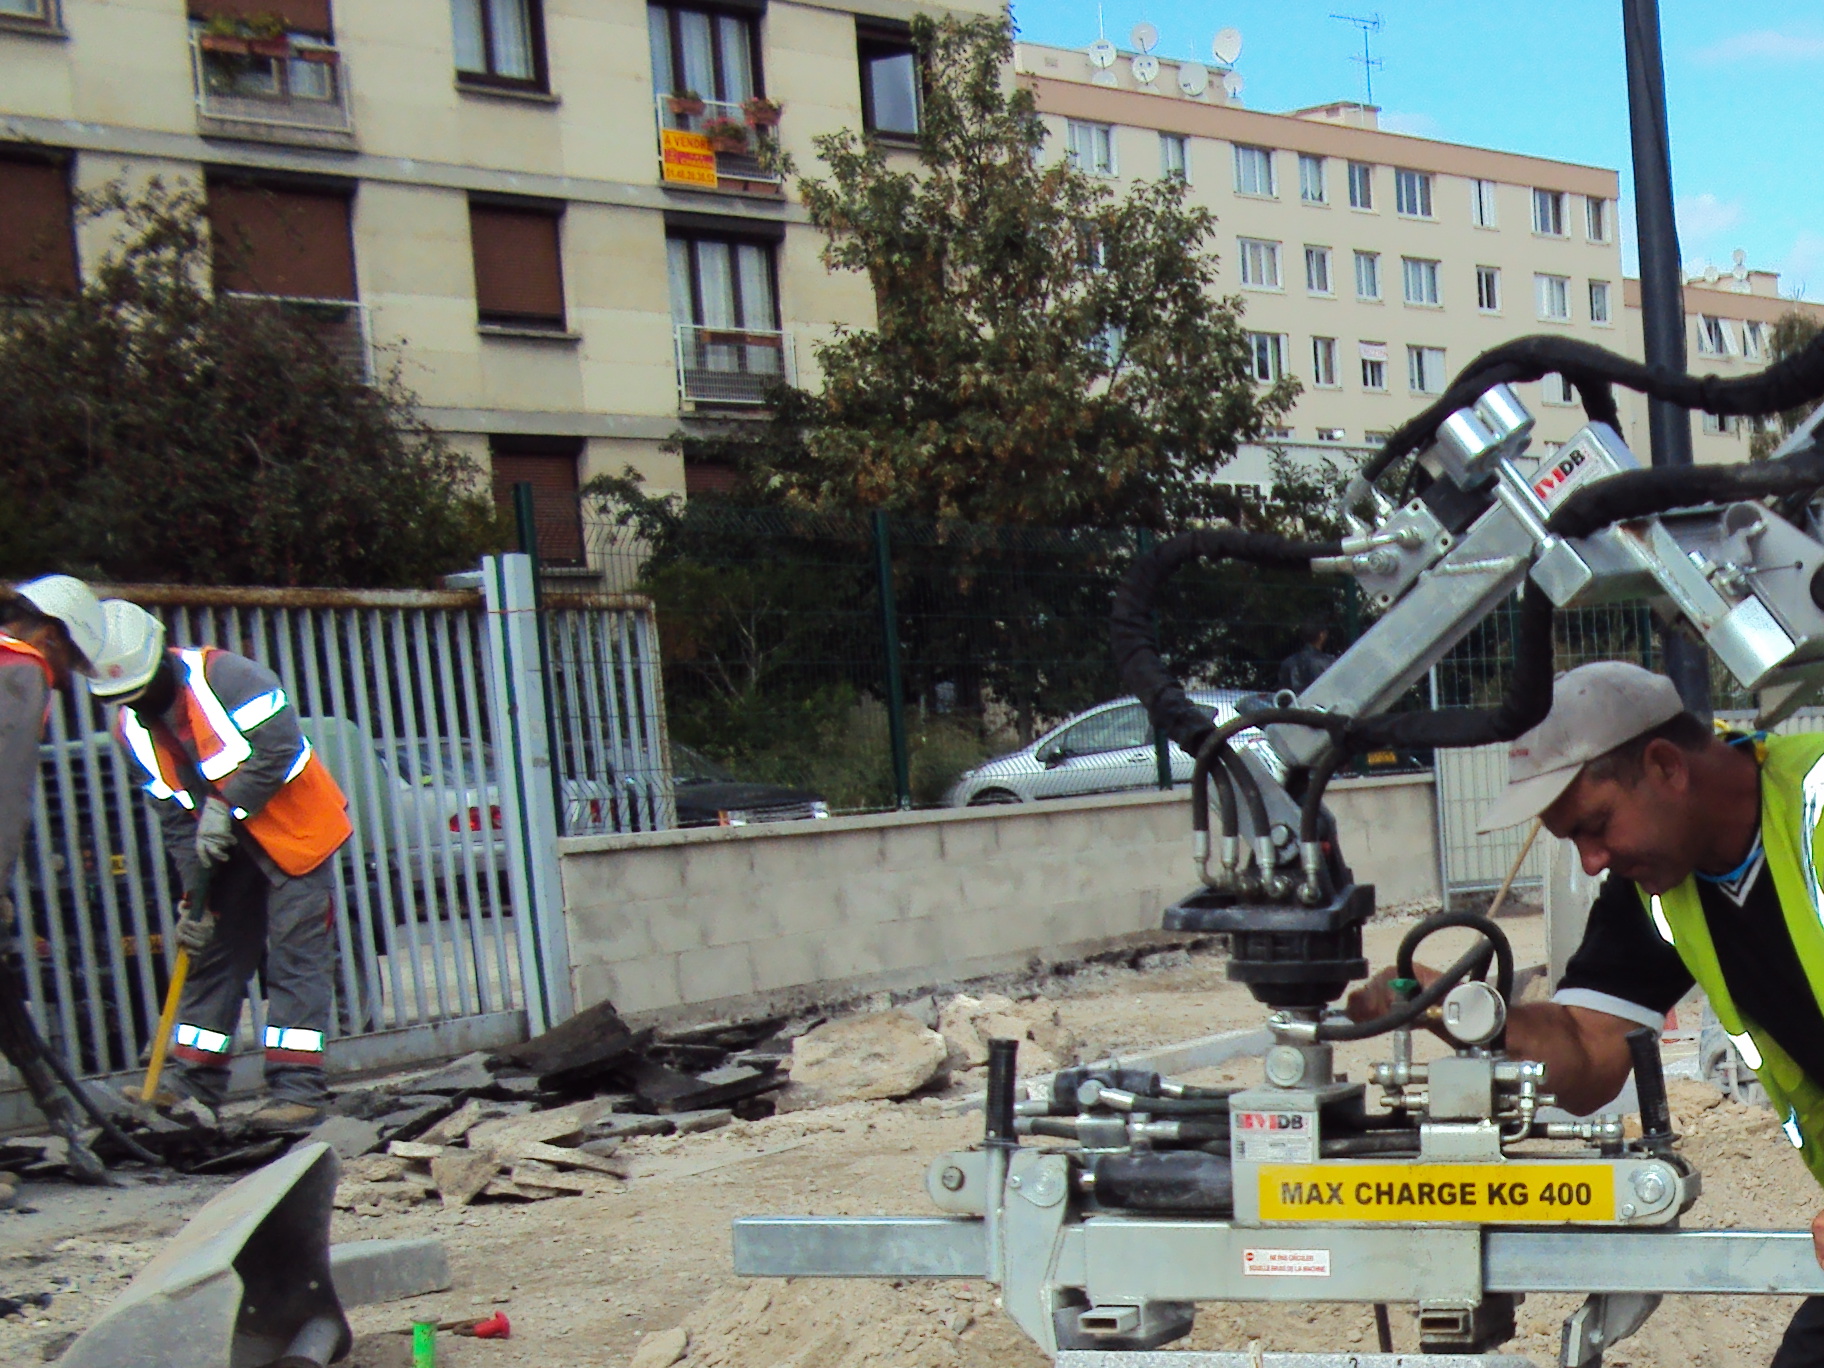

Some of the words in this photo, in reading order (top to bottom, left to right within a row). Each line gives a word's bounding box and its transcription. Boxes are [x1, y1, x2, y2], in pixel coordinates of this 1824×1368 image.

[1534, 449, 1587, 500] MDB
[1281, 1182, 1344, 1205] MAX
[1355, 1182, 1477, 1206] CHARGE
[1487, 1182, 1529, 1206] KG
[1539, 1182, 1592, 1206] 400
